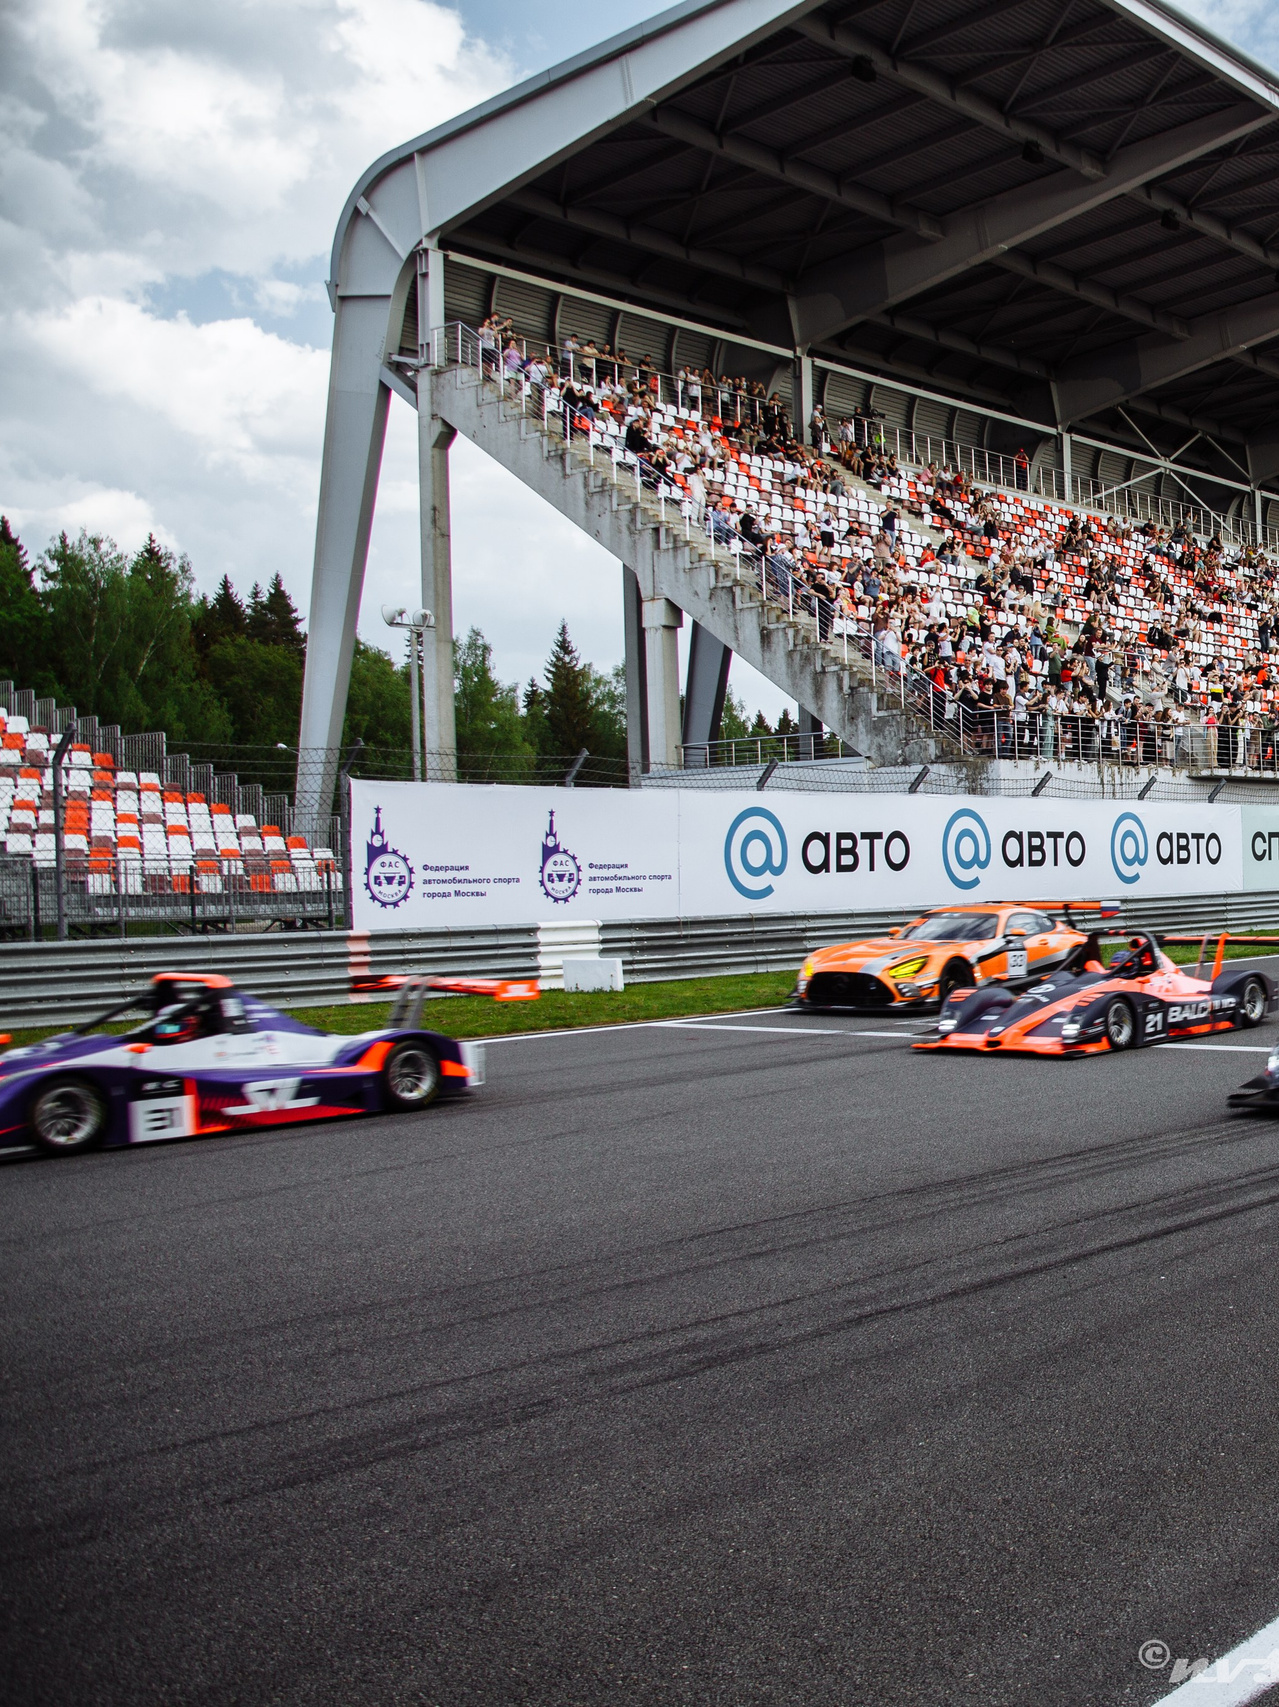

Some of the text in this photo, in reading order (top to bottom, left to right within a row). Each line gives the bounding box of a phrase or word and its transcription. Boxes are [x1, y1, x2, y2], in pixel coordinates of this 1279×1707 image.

[422, 864, 470, 872] Федерация
[588, 862, 629, 870] Федерация
[422, 876, 520, 885] автомобильного спорта
[588, 874, 672, 882] автомобильного спорта
[378, 889, 403, 899] МОСКВА
[422, 890, 487, 899] города Москвы
[588, 886, 643, 895] города Москвы
[1010, 954, 1025, 967] 33
[1145, 1012, 1163, 1033] 21
